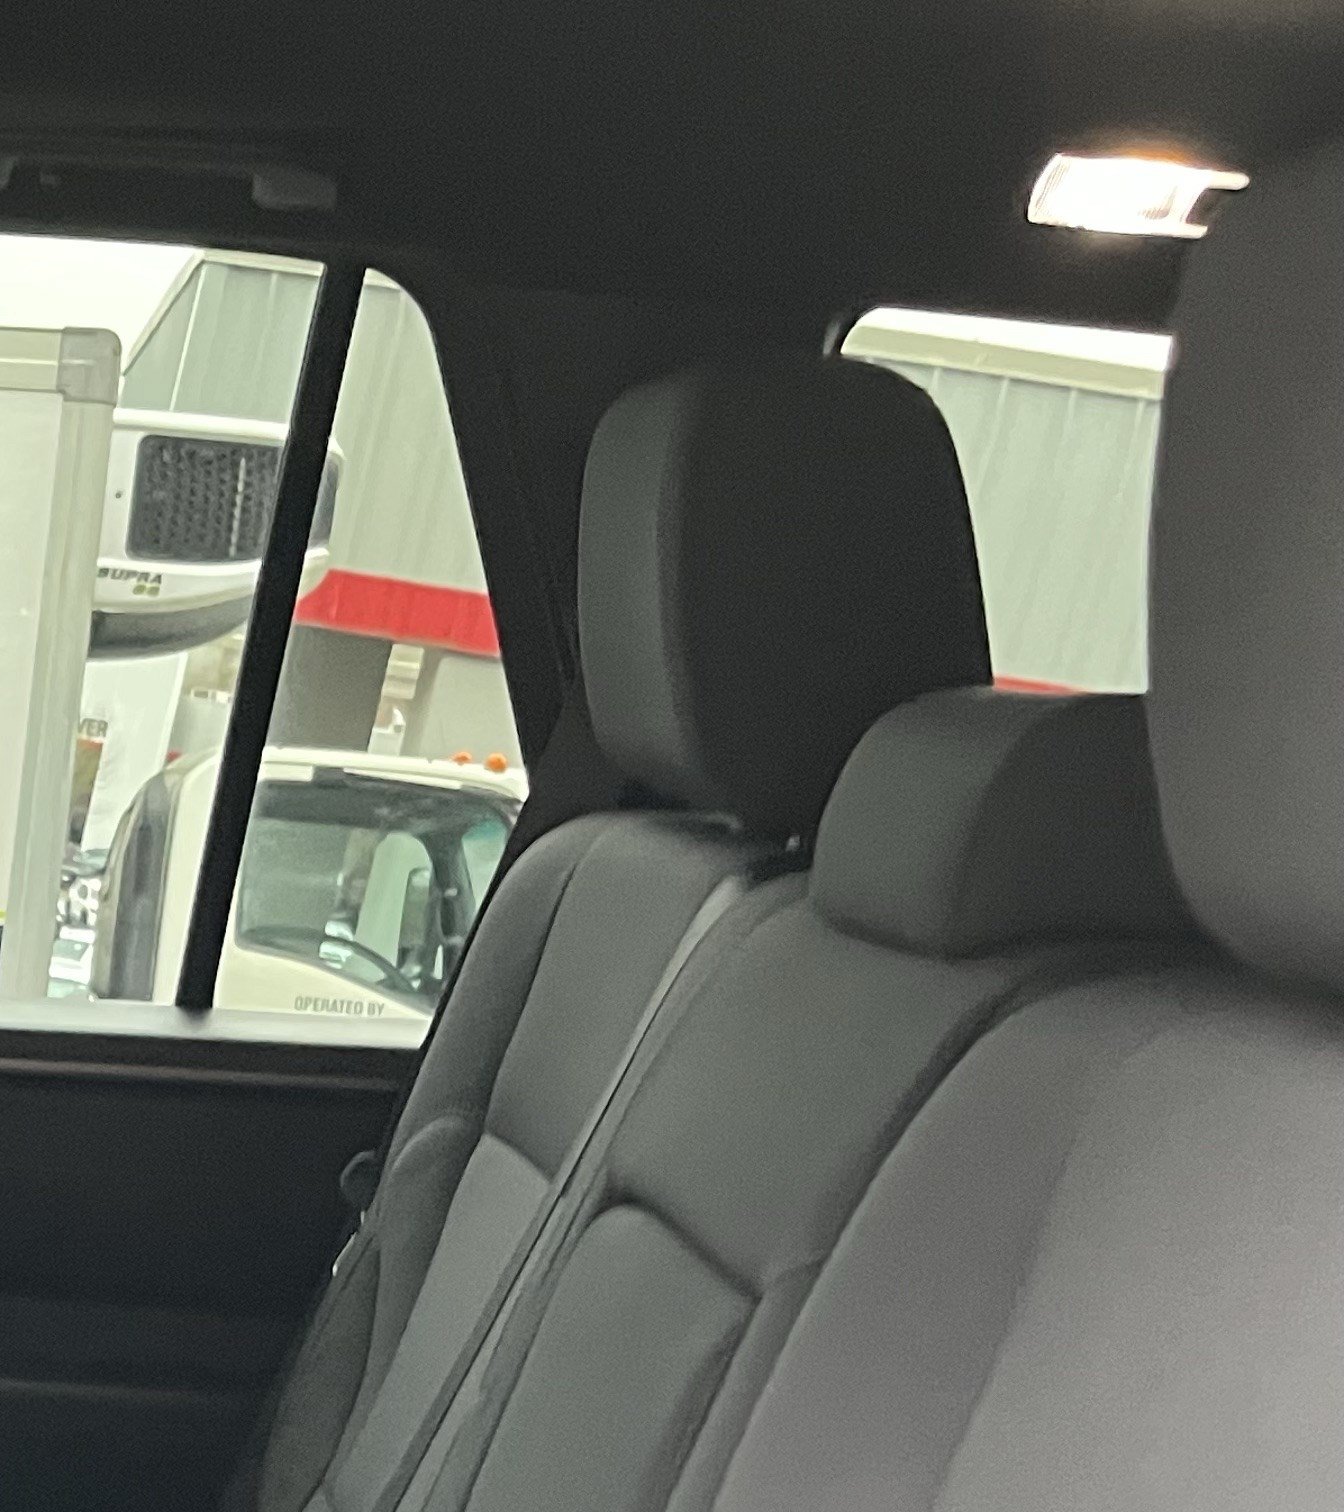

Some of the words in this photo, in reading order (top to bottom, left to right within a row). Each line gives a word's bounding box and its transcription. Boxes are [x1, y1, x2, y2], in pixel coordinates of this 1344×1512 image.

[97, 567, 162, 585] SUPRA
[293, 995, 364, 1015] OPERATED
[367, 1000, 386, 1017] BY
